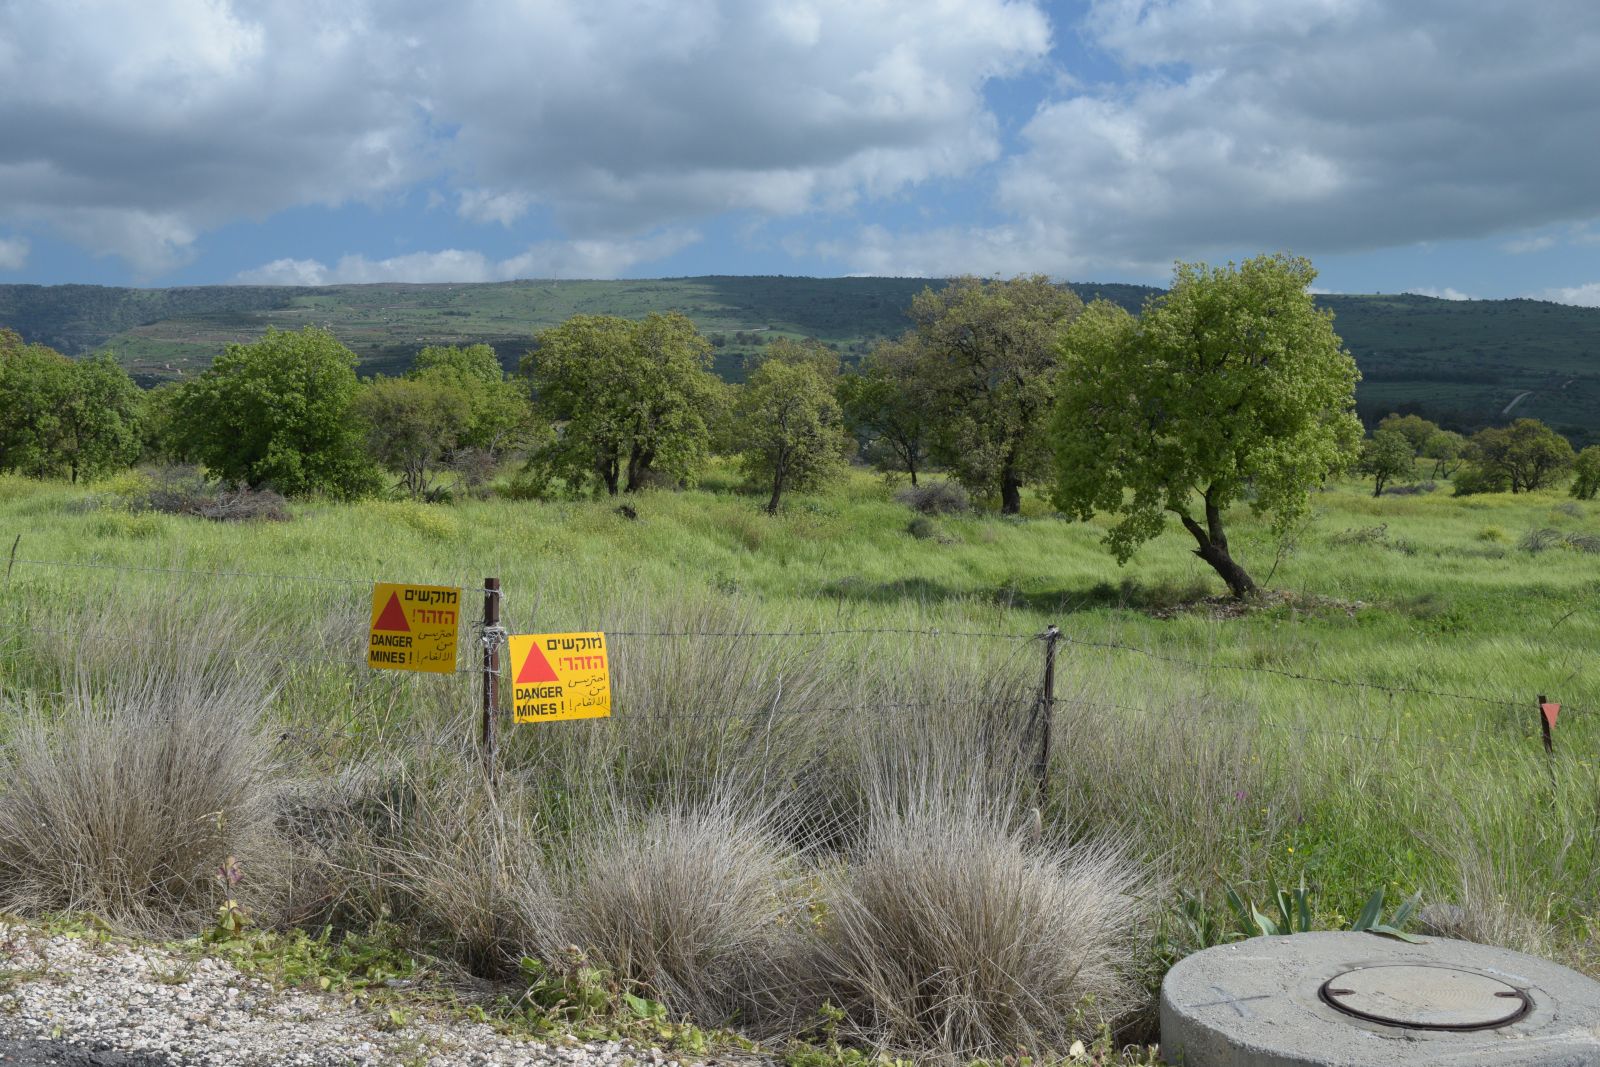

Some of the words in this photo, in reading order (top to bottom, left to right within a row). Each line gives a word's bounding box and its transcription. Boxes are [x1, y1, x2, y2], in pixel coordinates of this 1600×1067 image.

[405, 589, 457, 605] מוקשים
[371, 634, 413, 648] DANGER
[547, 637, 602, 652] מוקשים
[515, 686, 563, 700] DANGER
